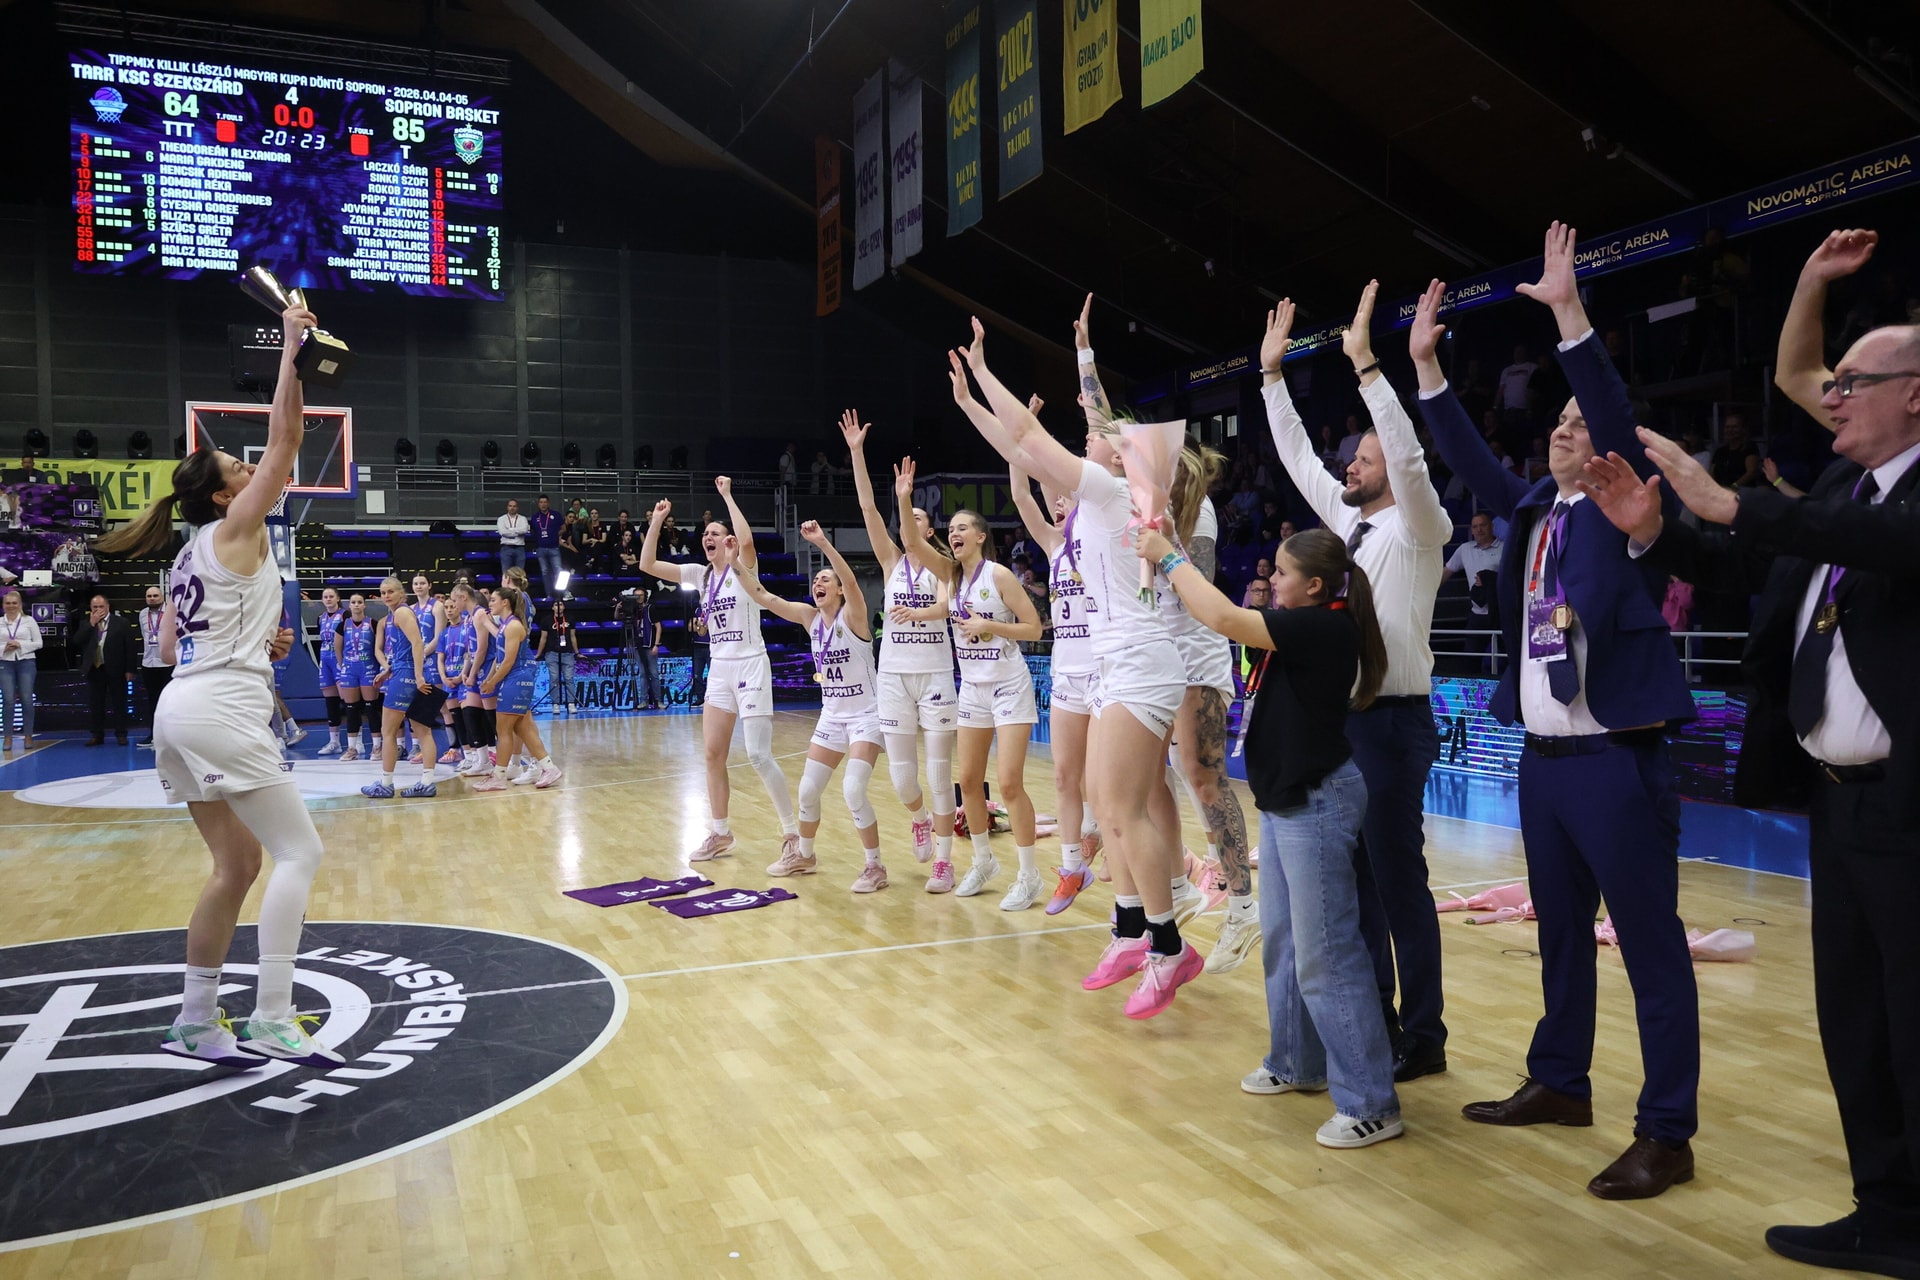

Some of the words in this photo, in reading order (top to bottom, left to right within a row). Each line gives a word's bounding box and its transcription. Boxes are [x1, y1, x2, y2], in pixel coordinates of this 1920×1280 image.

[1000, 11, 1032, 92] 2002
[71, 63, 114, 82] TARR
[118, 68, 150, 86] KSC
[153, 72, 244, 96] SZEKSZÁRD
[108, 53, 154, 69] TIPPMIX
[157, 58, 190, 73] KILLIK
[192, 62, 232, 78] LÁSZLÓ
[234, 68, 278, 83] MAGYAR
[280, 73, 308, 86] KUPA
[345, 80, 385, 95] SOPRON
[394, 86, 468, 105] 2026.04.04-05
[164, 92, 199, 118] 64
[285, 86, 298, 104] 4
[274, 104, 314, 129] 0.0
[385, 99, 442, 118] SOPRON
[446, 105, 499, 124] BASKET
[162, 120, 195, 137] TTT
[392, 117, 425, 142] 85
[80, 133, 89, 144] 3
[159, 140, 228, 157] THEODOREÁN
[231, 148, 291, 163] ALEXANDRA
[262, 129, 325, 150] 20:23
[81, 145, 89, 156] 5
[146, 151, 154, 162] 6
[160, 152, 194, 165] MARIA
[400, 145, 411, 159] T
[77, 168, 91, 179] 10
[142, 174, 155, 185] 18
[160, 176, 202, 188] DOMBAI
[204, 179, 232, 191] RÉKA
[81, 157, 89, 167] 9
[160, 164, 205, 177] HENCSIK
[207, 168, 253, 182] ADRIENN
[364, 161, 400, 174] LACZKÓ
[402, 164, 428, 176] SÁRA
[435, 168, 442, 178] 5
[486, 173, 498, 184] 10
[78, 180, 91, 190] 17
[146, 186, 155, 197] 9
[160, 187, 212, 201] CAROLINA
[214, 192, 273, 206] RODRIGUES
[369, 184, 400, 195] ROKOB
[403, 187, 428, 198] ZORA
[435, 189, 443, 199] 9
[370, 173, 398, 184] SINKA
[401, 176, 428, 187] SZOFI
[435, 179, 443, 188] 8
[490, 184, 498, 194] 6
[1748, 172, 1845, 215] NOVOMATIC
[1850, 154, 1911, 182] ARÉNA
[76, 191, 92, 202] 22
[147, 197, 155, 208] 6
[161, 199, 202, 212] CYESHA
[205, 202, 239, 215] GOREE
[361, 194, 386, 204] PAPP
[389, 196, 429, 208] KLAUDIA
[432, 200, 444, 210] 10
[1805, 187, 1846, 205] SOPRON
[77, 203, 93, 214] 32
[142, 208, 156, 220] 16
[161, 210, 191, 222] ALIZA
[194, 213, 234, 225] KARLEN
[341, 203, 380, 215] JOVANA
[383, 207, 429, 219] JEVTOVIC
[432, 211, 444, 220] 12
[77, 226, 93, 237] 55
[161, 233, 194, 245] NYÁRI
[78, 215, 92, 226] 41
[147, 220, 155, 231] 5
[198, 223, 232, 236] GRÉTA
[342, 225, 370, 236] SITKU
[373, 228, 429, 241] ZSUZSANNA
[432, 233, 445, 242] 15
[491, 237, 498, 247] 3
[350, 215, 374, 226] ZALA
[377, 217, 429, 230] FRISKOVEC
[432, 222, 444, 232] 13
[487, 226, 499, 237] 21
[78, 238, 93, 249] 66
[148, 243, 156, 254] 4
[162, 245, 195, 256] HOLCZ
[198, 247, 239, 260] REBEKA
[357, 237, 382, 248] TARA
[385, 240, 430, 252] WALLACK
[432, 243, 445, 252] 17
[491, 248, 498, 258] 6
[1574, 242, 1621, 264] OMATIC
[1625, 229, 1669, 250] ARÉNA
[78, 250, 94, 261] 88
[186, 258, 237, 271] DOMINIKA
[328, 256, 381, 270] SAMANTHA
[384, 261, 430, 273] FUEHRING
[432, 265, 446, 275] 33
[489, 269, 498, 278] 11
[353, 248, 389, 259] JELENA
[392, 251, 430, 263] BROOKS
[432, 254, 446, 264] 32
[487, 258, 500, 268] 22
[1591, 254, 1622, 268] SOPRON
[399, 273, 430, 284] VIVIEN
[432, 275, 446, 286] 44
[492, 280, 499, 290] 6
[1457, 282, 1491, 300] ARÉNA
[1438, 302, 1455, 312] OPRON
[1329, 324, 1350, 338] ARÉN
[1190, 364, 1225, 381] NOVOMATIC
[1227, 356, 1248, 369] ARÉNA
[1062, 601, 1070, 619] 9
[714, 613, 727, 629] 15
[827, 667, 843, 682] 44
[250, 946, 467, 1114] HUNBASKET
